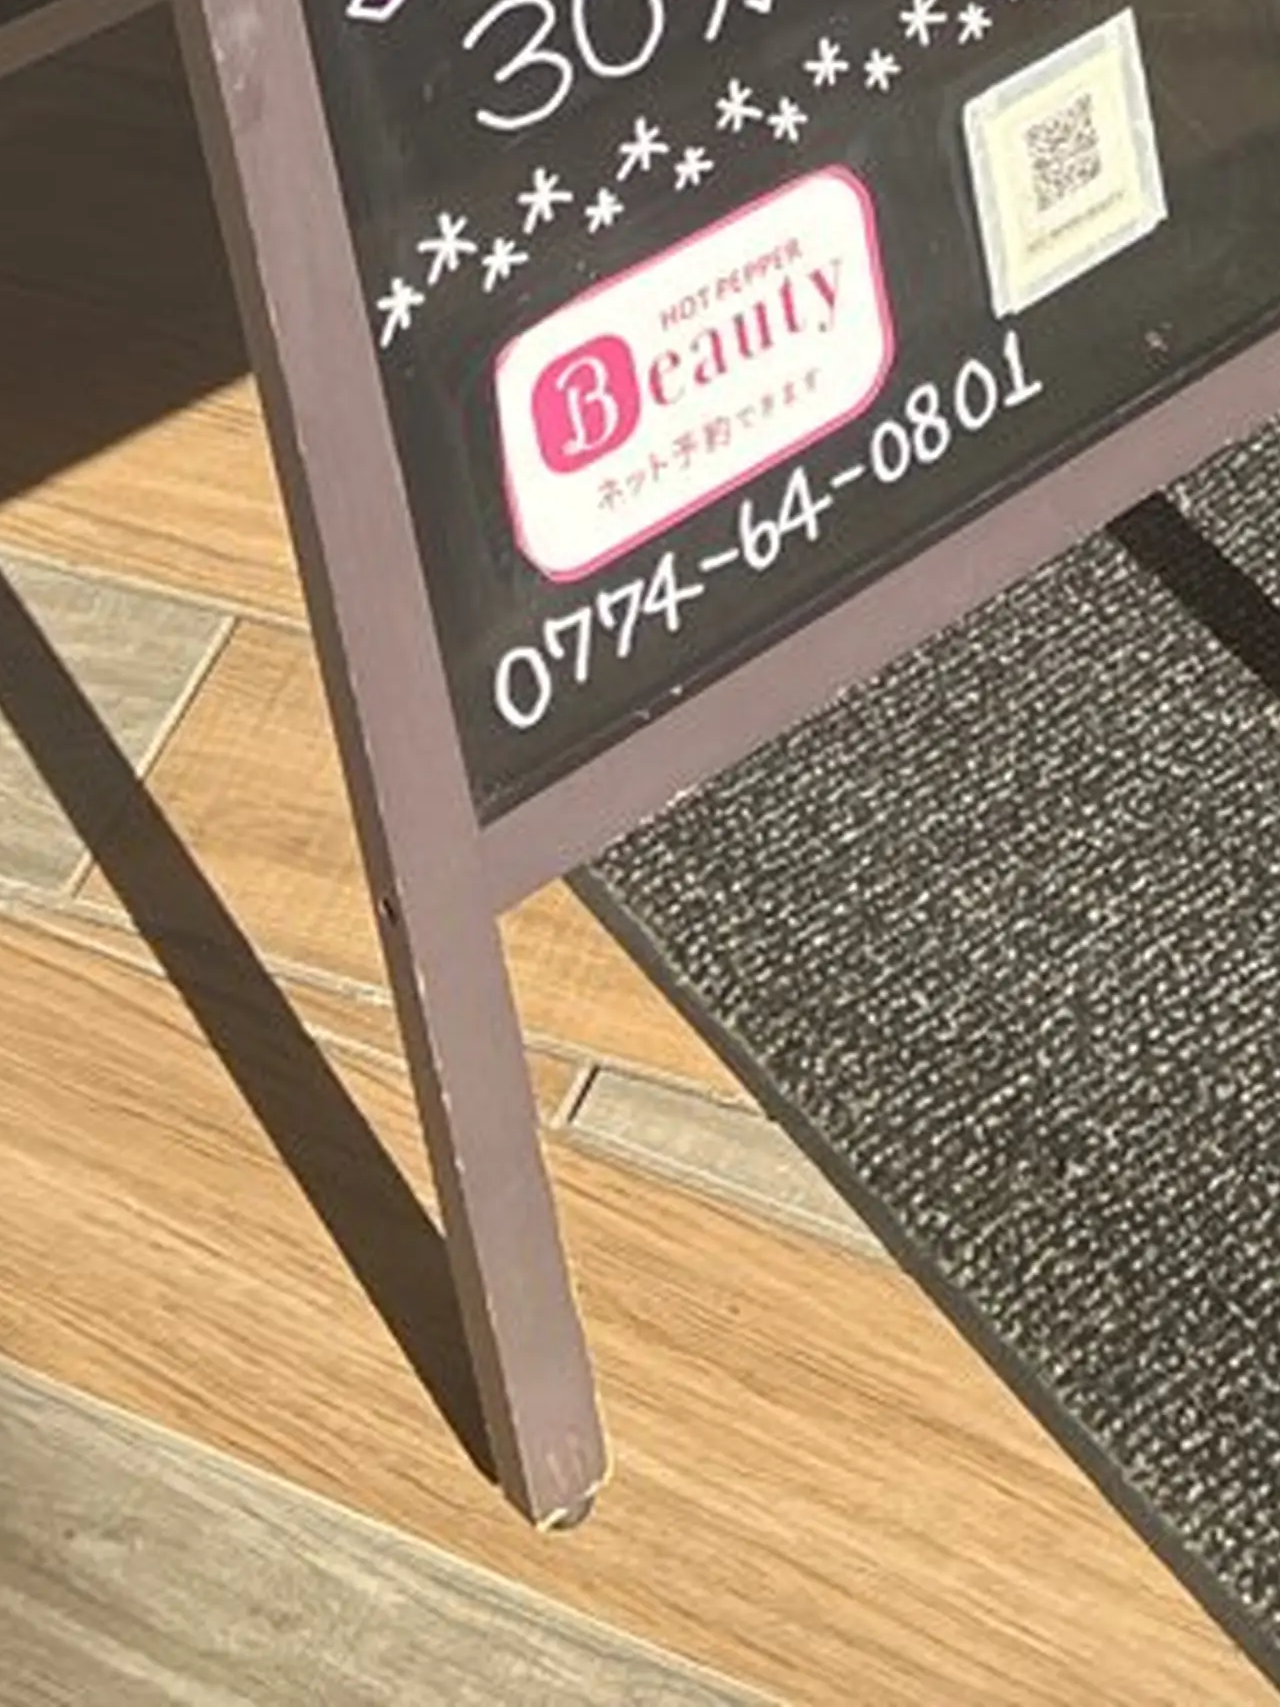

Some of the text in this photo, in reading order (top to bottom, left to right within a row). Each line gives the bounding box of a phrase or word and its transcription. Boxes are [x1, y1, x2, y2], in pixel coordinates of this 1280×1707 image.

[556, 255, 848, 459] Beauty
[659, 236, 804, 333] HOT PEPPER
[595, 365, 822, 513] ネット予約できます
[493, 327, 1045, 729] 0774-64-0801
